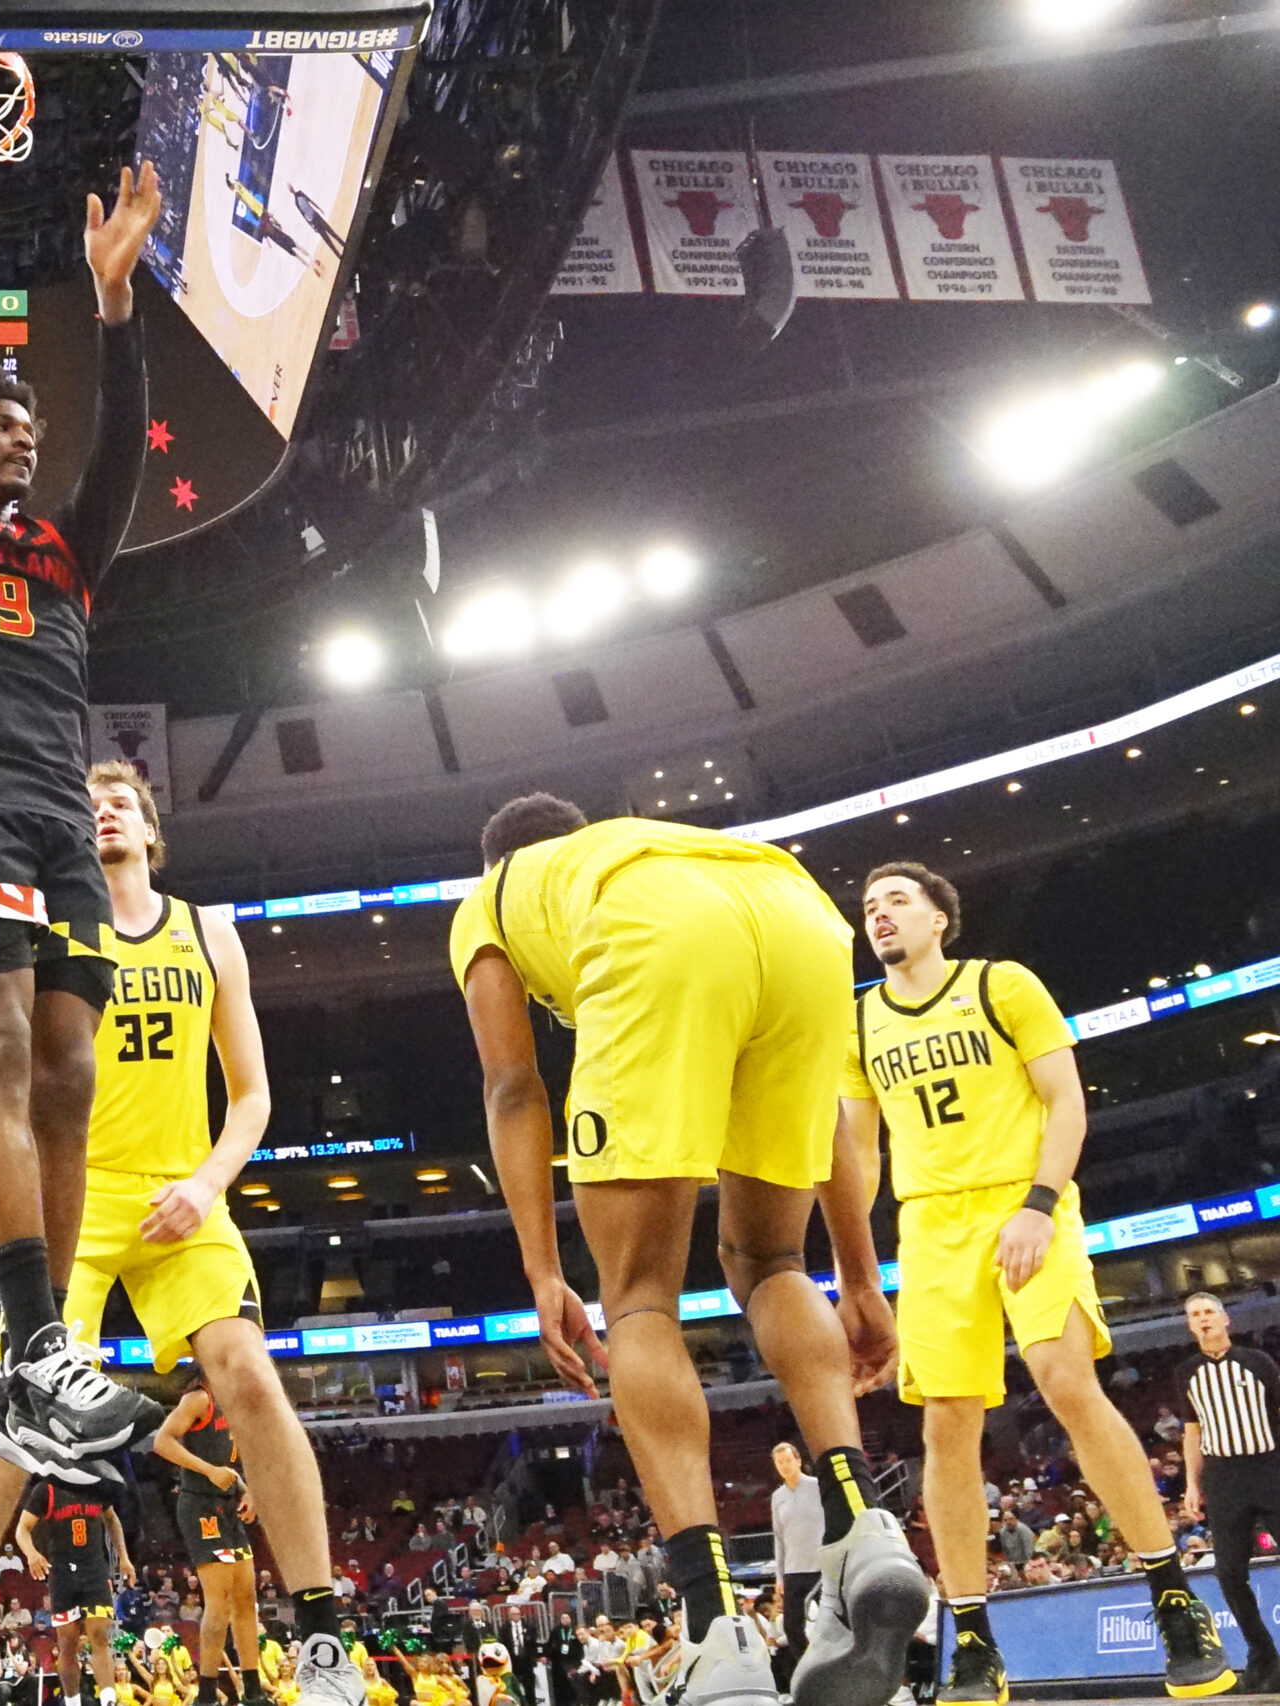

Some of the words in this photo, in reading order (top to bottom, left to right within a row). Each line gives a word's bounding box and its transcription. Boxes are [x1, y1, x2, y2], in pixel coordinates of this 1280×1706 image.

[43, 32, 112, 45] Allstate
[648, 160, 733, 173] CHICAGO
[773, 161, 857, 175] CHICAGO
[894, 163, 978, 177] CHICAGO
[1019, 165, 1102, 179] CHICAGO
[666, 176, 725, 188] BULLS
[790, 176, 849, 190] BULLS
[912, 178, 969, 192] BULLS
[1036, 180, 1093, 194] BULLS
[681, 238, 730, 247] EASTERN
[672, 250, 741, 260] CONFERENC
[674, 263, 742, 273] CHAMPION
[1, 296, 19, 311] O
[112, 966, 202, 1008] EGON
[1104, 1007, 1139, 1027] TIAA
[115, 1012, 173, 1062] 32
[871, 1030, 992, 1092] OREGON
[914, 1077, 965, 1129] 12
[310, 1142, 346, 1156] 13.3%
[346, 1140, 374, 1154] FT%
[1199, 1200, 1253, 1222] TIAA.ORG
[433, 1323, 480, 1339] TIAA.ORG
[72, 1519, 87, 1546] 8
[200, 1516, 221, 1539] M
[1214, 1611, 1238, 1628] STA
[1102, 1615, 1151, 1643] Hilton
